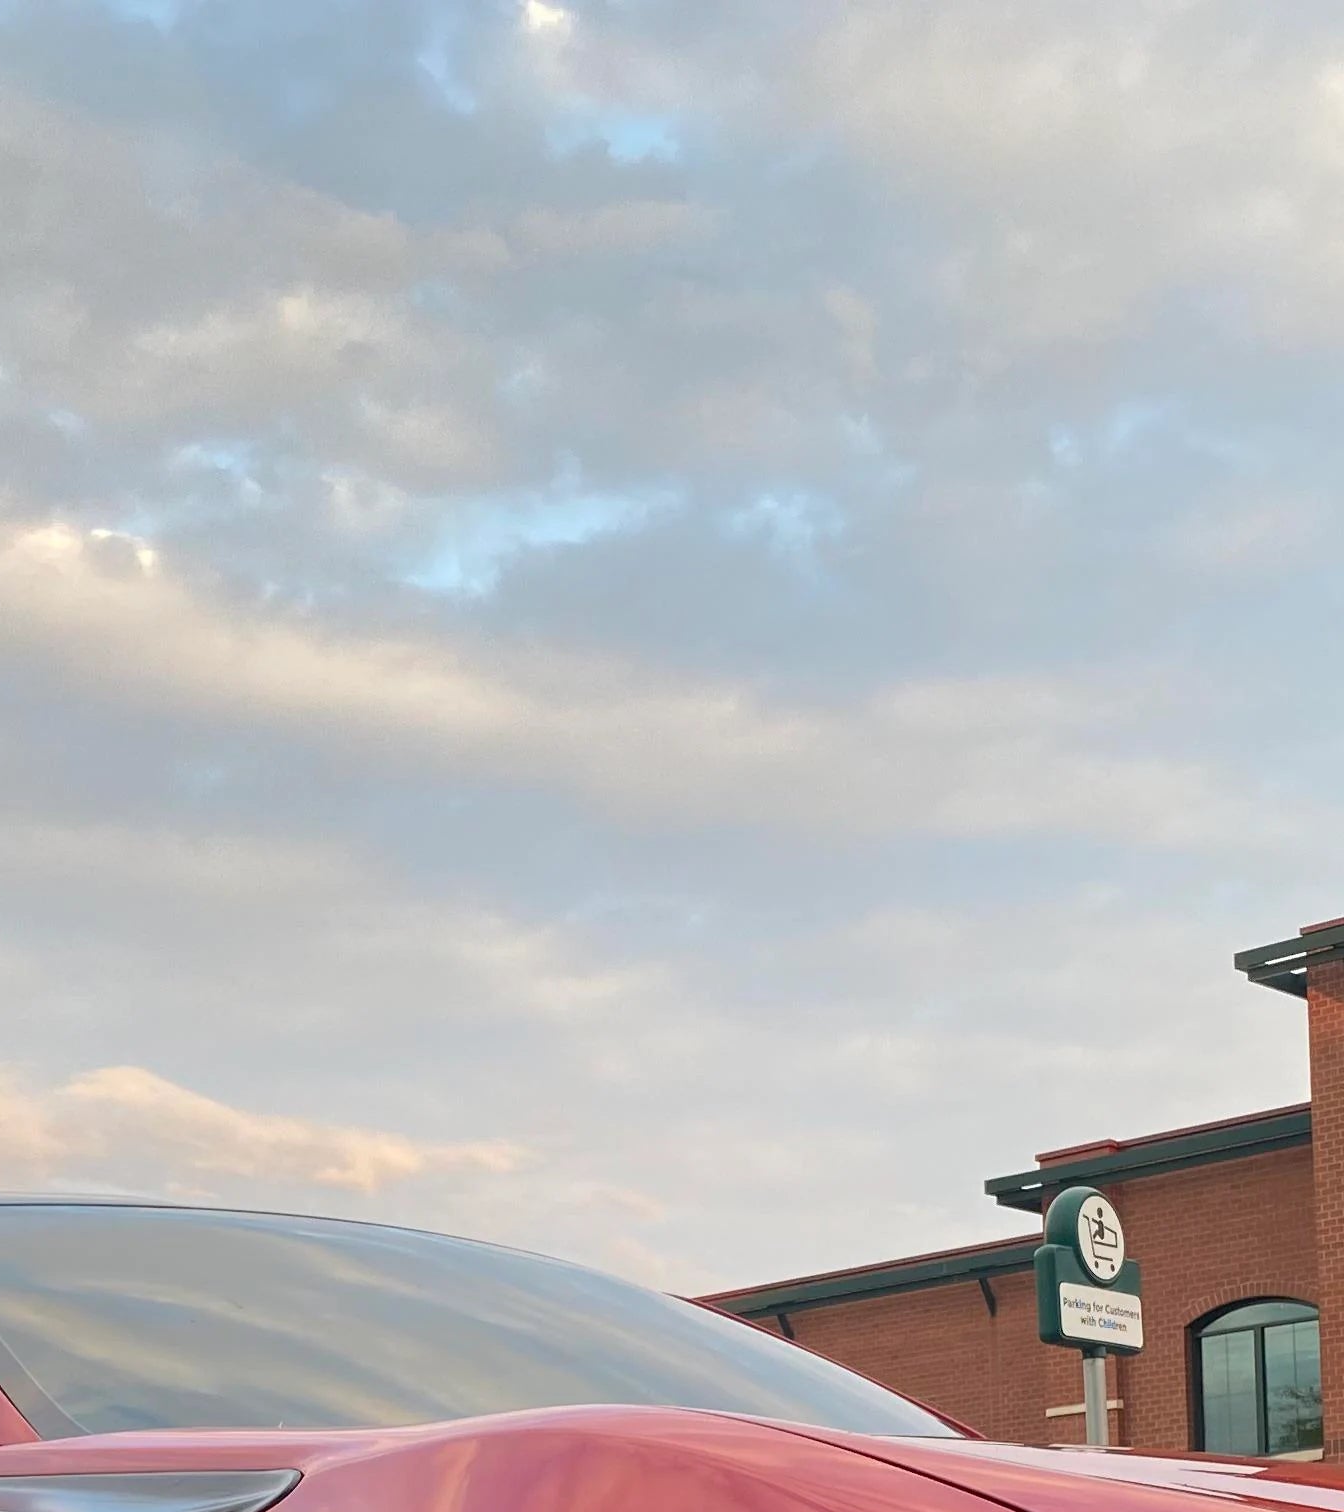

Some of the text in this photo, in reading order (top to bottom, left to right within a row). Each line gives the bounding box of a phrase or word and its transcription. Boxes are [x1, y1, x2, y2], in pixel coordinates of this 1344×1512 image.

[1063, 1296, 1140, 1320] Parking for Customers
[1081, 1315, 1127, 1332] with Children
